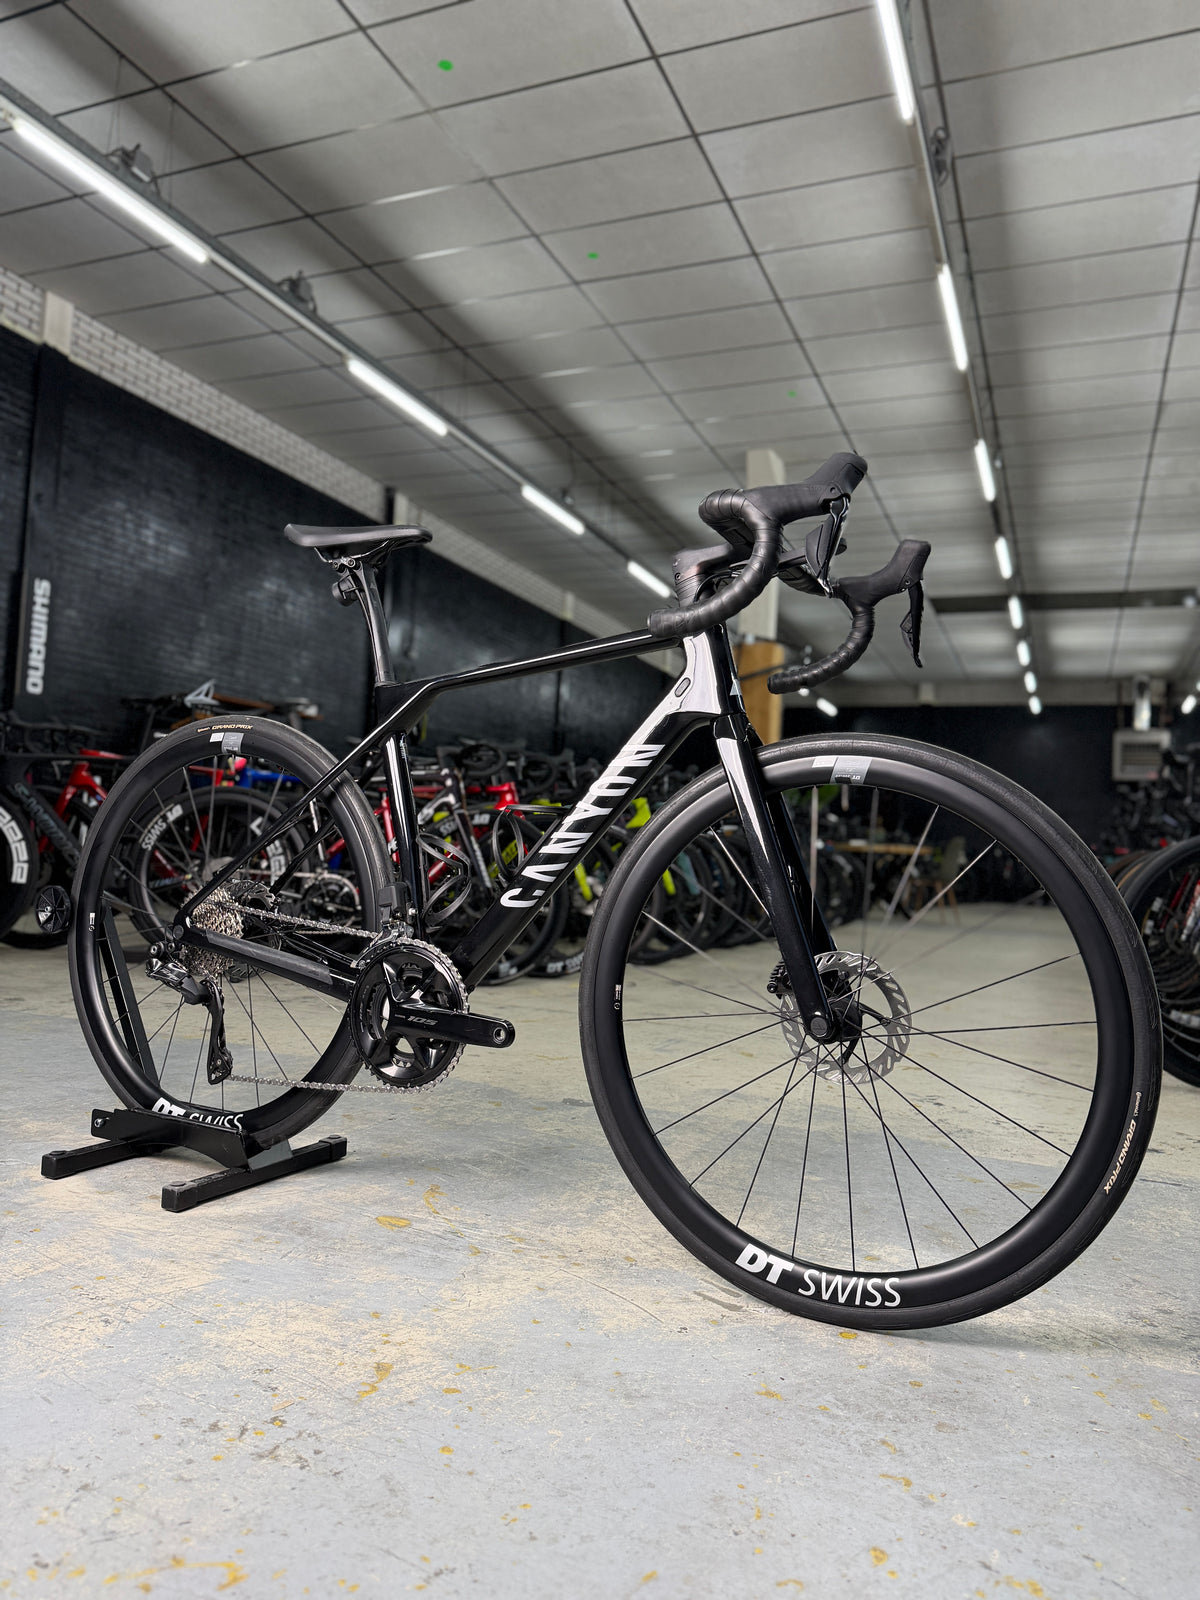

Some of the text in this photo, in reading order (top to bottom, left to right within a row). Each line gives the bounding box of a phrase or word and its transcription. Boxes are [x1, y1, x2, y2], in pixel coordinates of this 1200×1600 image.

[26, 577, 51, 695] SHIMANO
[141, 819, 167, 851] SWISS
[500, 744, 666, 908] CANYON
[151, 1097, 187, 1117] DT
[1119, 1119, 1137, 1165] GRAND
[735, 1243, 901, 1308] DT SWISS
